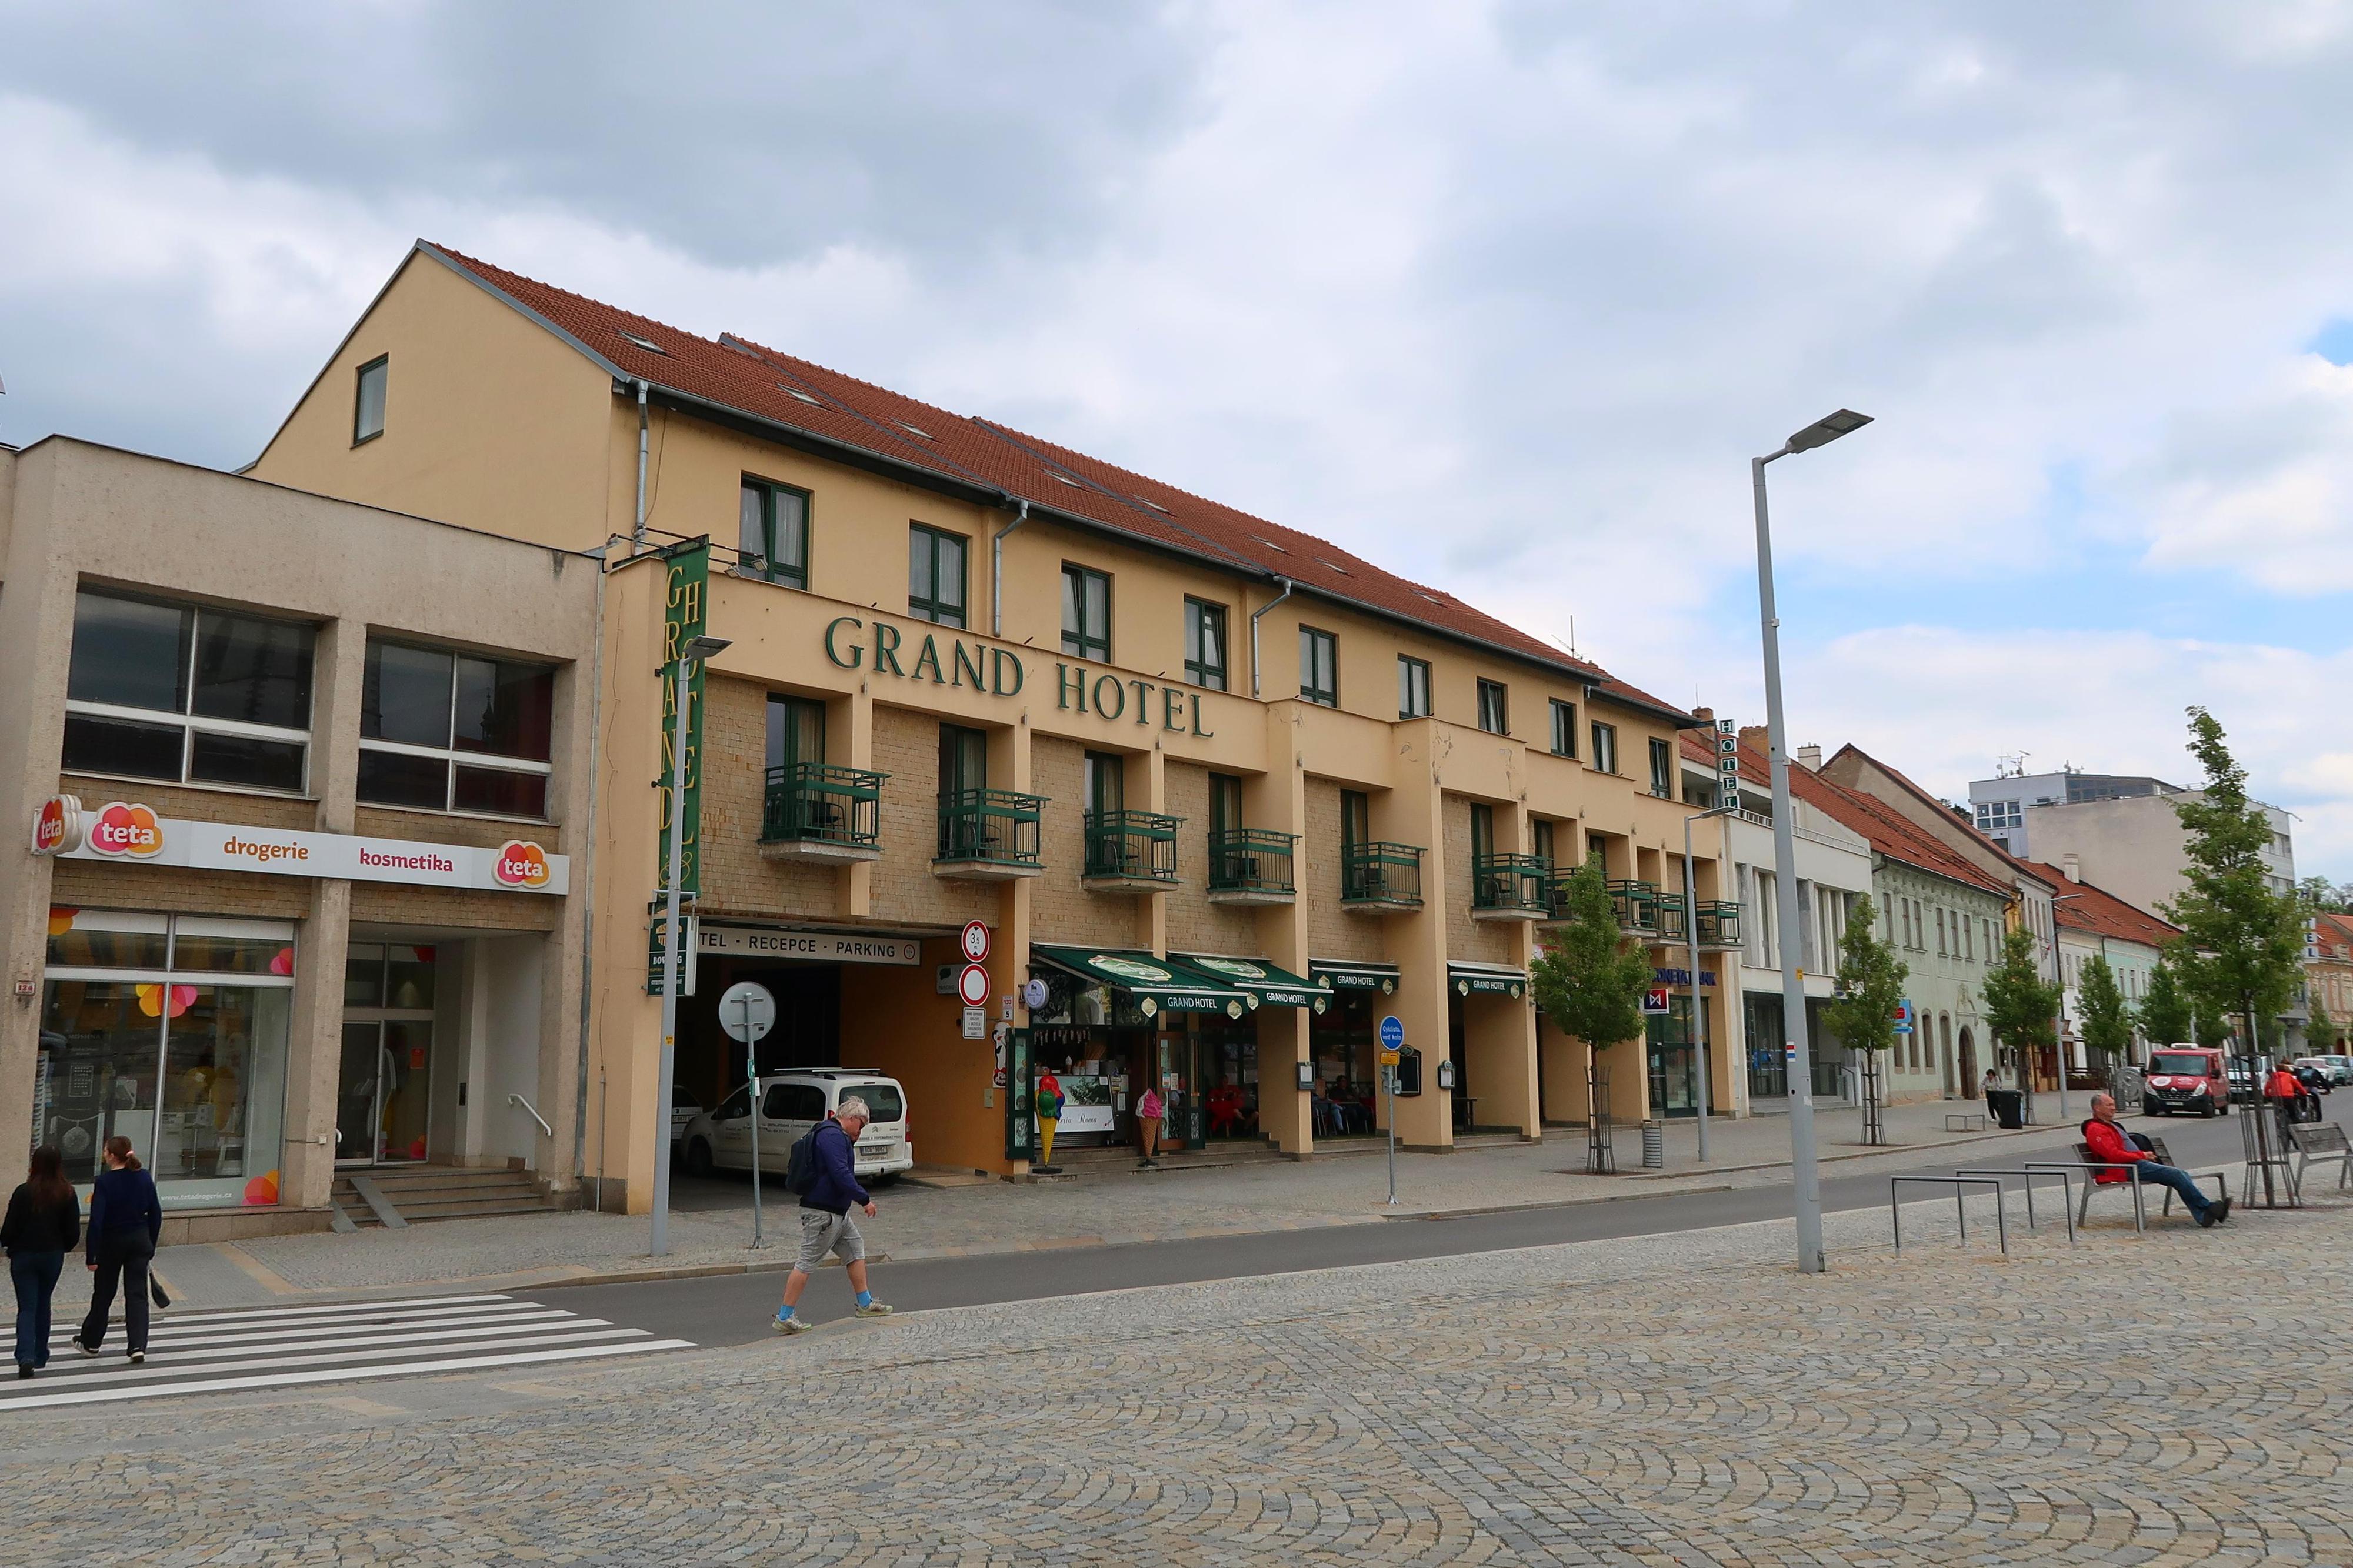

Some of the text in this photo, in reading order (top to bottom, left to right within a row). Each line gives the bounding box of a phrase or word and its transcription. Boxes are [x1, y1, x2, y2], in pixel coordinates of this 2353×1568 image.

[825, 616, 1214, 738] GRAND HOTEL
[659, 565, 684, 831] GRAND
[1721, 721, 1737, 808] HOTEL
[41, 818, 62, 840] teta
[102, 822, 543, 877] teta drogerie kosmetika teta
[2301, 889, 2315, 958] HTEL
[699, 933, 727, 948] TEL
[749, 936, 816, 952] RECEPCE
[836, 942, 895, 958] PARKING
[1337, 975, 1375, 986] GRAND HOTEL
[1473, 980, 1505, 990] GRAND HOTEL
[1168, 997, 1217, 1009] GRAND HOTEL
[1266, 992, 1307, 1005] GRAND HOTEL
